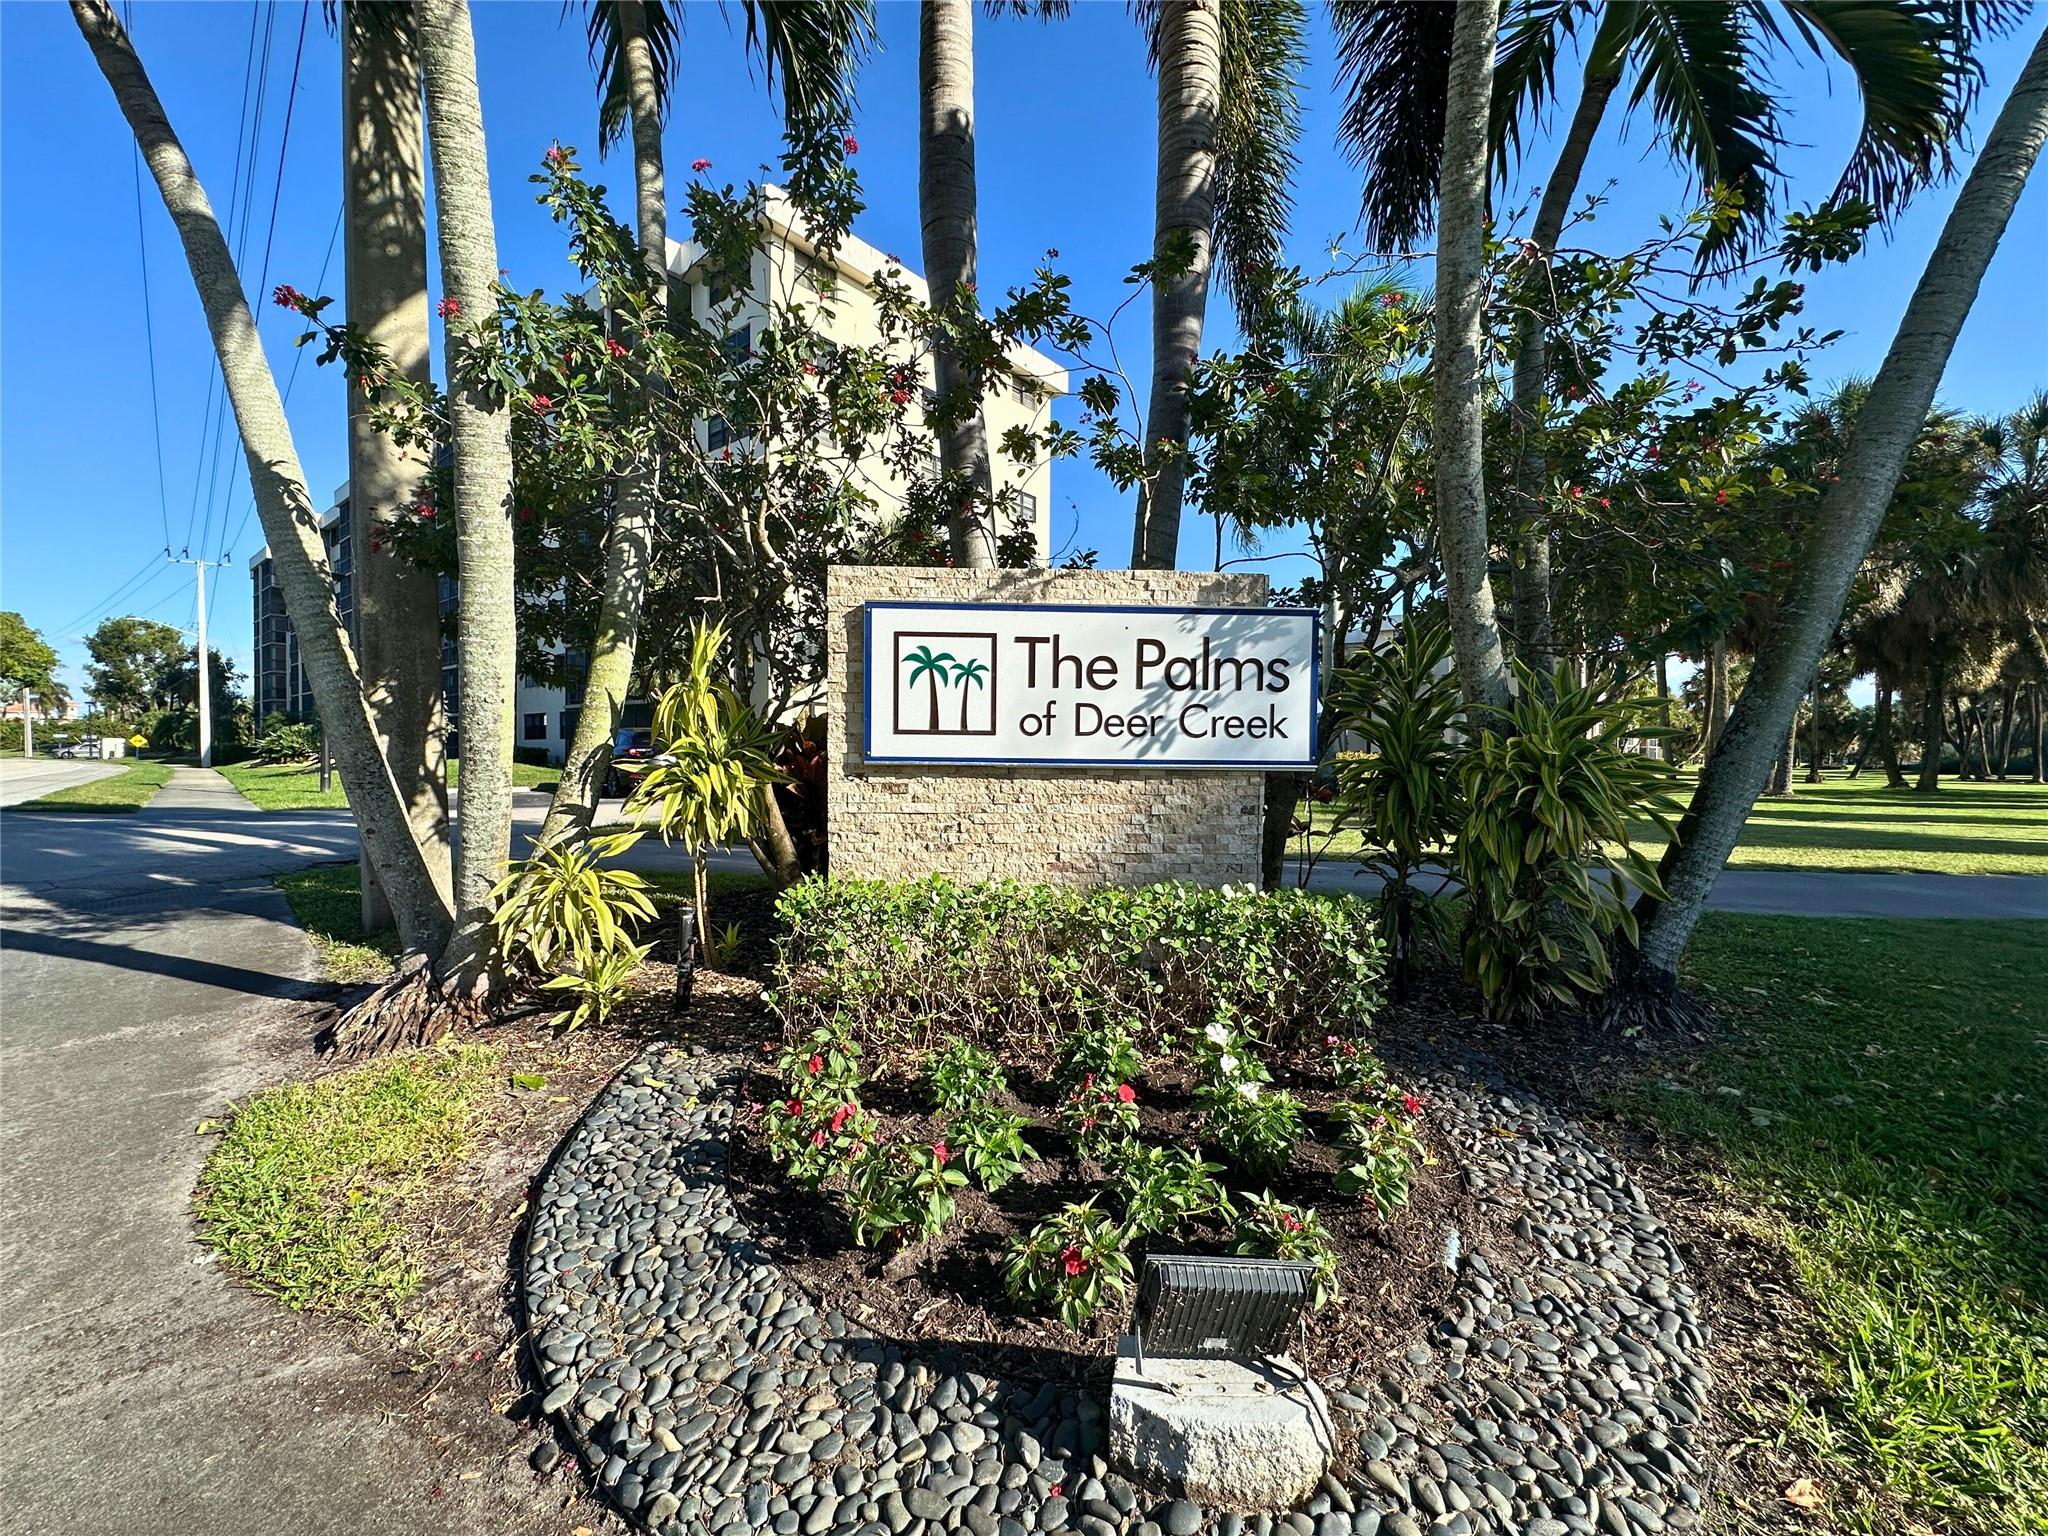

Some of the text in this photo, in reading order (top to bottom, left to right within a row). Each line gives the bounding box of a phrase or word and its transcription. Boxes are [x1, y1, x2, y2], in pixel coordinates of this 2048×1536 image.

[1014, 634, 1290, 692] The Palms
[1019, 700, 1289, 739] of Deer Creek
